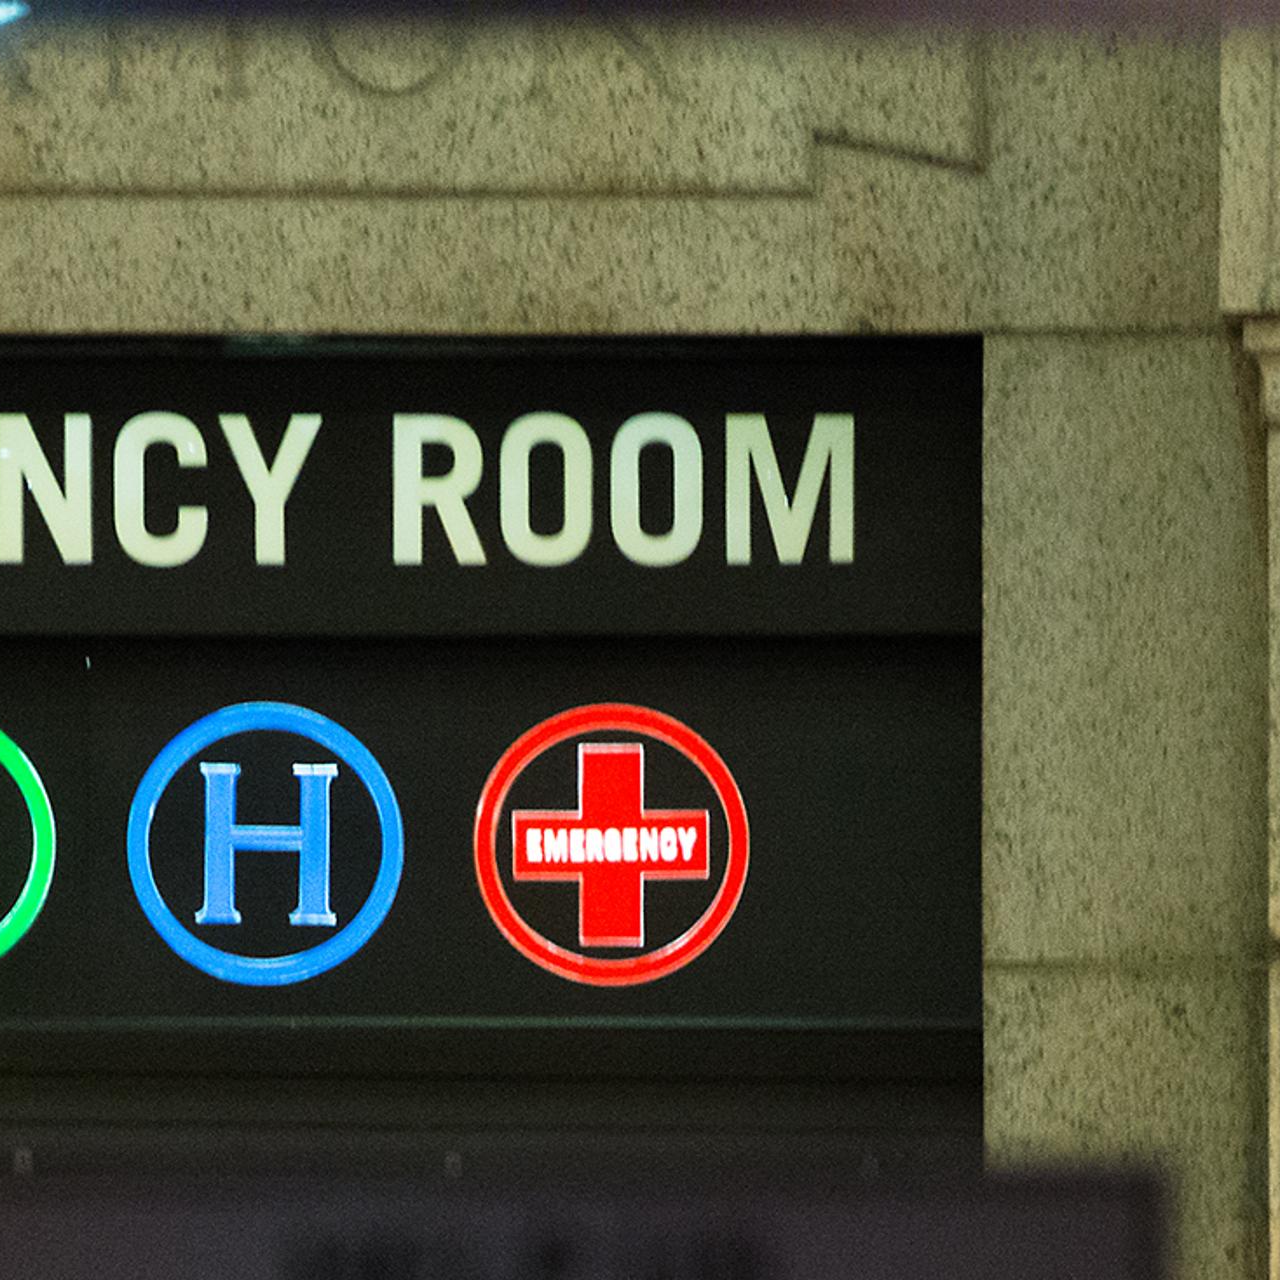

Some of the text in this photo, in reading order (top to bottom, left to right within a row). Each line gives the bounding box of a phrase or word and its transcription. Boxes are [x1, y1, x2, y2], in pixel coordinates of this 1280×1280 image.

[392, 411, 855, 568] ROOM
[194, 761, 339, 928] H
[525, 826, 697, 864] EMERGENCY
